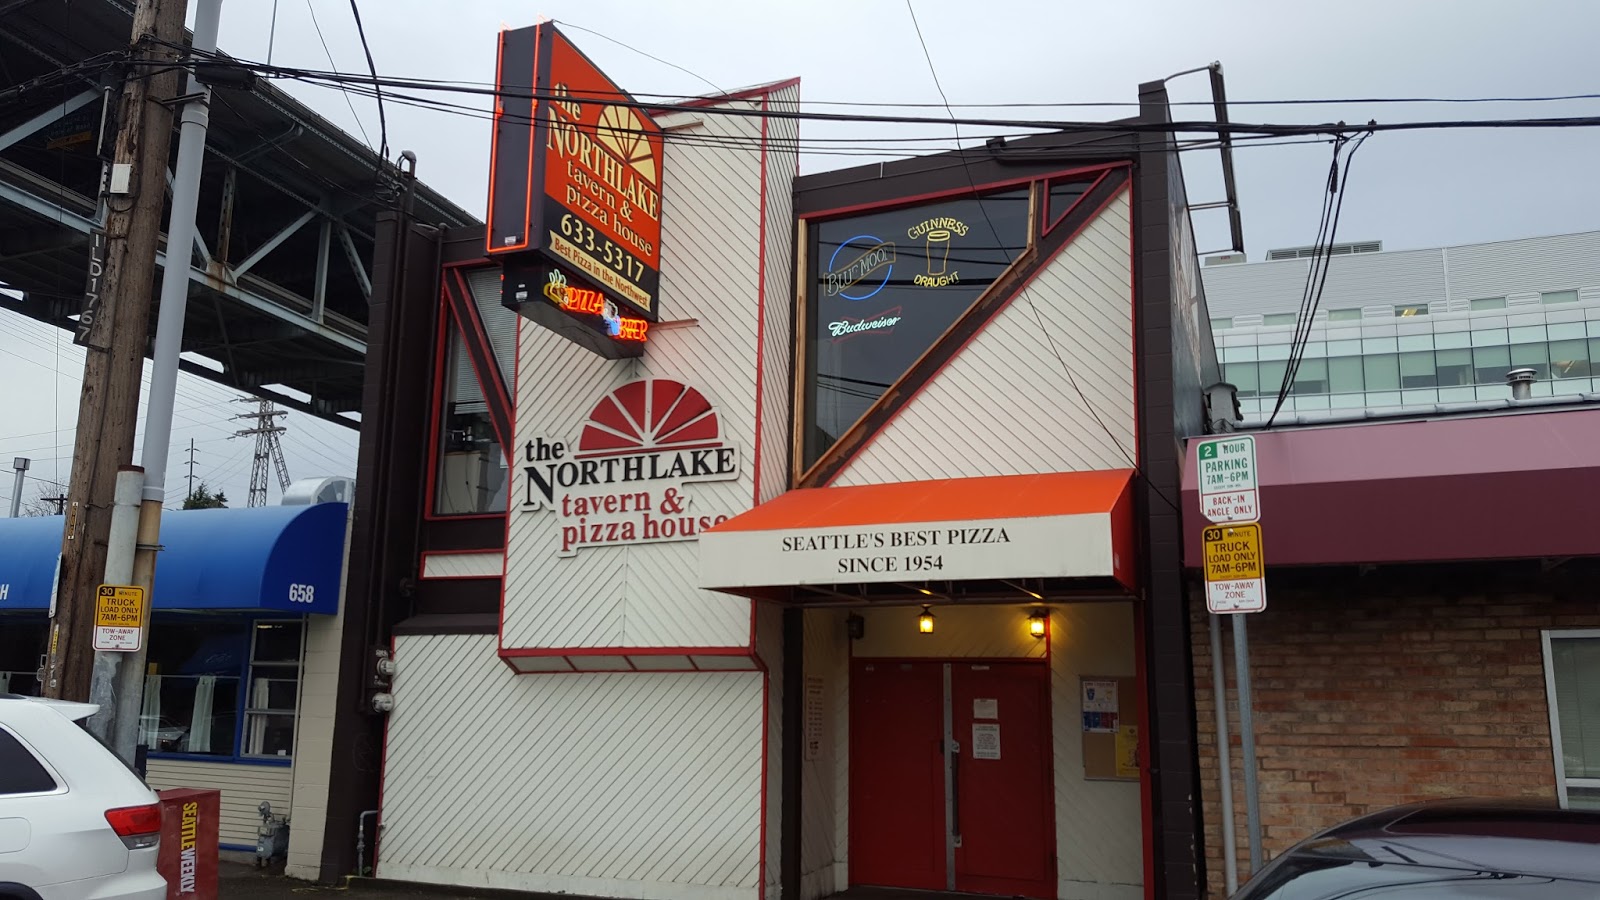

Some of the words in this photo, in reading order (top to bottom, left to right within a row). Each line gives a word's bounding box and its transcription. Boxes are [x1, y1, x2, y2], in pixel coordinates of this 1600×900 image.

[554, 83, 581, 120] the
[546, 106, 659, 221] NORTHLAKE
[567, 159, 615, 210] tavern
[619, 201, 633, 222] &
[566, 184, 608, 226] pizza
[613, 213, 652, 257] house
[907, 216, 970, 240] GUINNESS
[560, 213, 645, 283] 633-5317
[554, 237, 571, 252] Best
[573, 250, 592, 271] Pizza
[593, 262, 601, 273] in
[602, 269, 614, 285] the
[614, 275, 648, 307] Northwest
[913, 271, 960, 288] DRAUGHT
[567, 286, 605, 315] PIZZA
[827, 316, 902, 337] Budweiser
[525, 437, 564, 462] the
[1204, 445, 1212, 457] 2
[1223, 442, 1246, 454] HOUR
[1205, 457, 1248, 473] PARKING
[523, 447, 736, 507] NORTHLAKE
[1206, 470, 1249, 485] 7AM-6PM
[561, 490, 651, 517] tavern
[659, 487, 685, 515] &
[1212, 495, 1246, 505] BACK-IN
[1207, 506, 1230, 517] ANGLE
[1234, 504, 1253, 515] ONLY
[562, 517, 636, 552] pizza
[782, 532, 885, 552] SEATTLE'S
[890, 529, 941, 548] BEST
[947, 527, 1011, 545] PIZZA
[1207, 529, 1220, 540] 30
[1213, 541, 1250, 553] TRUCK
[837, 556, 898, 574] SINCE
[904, 555, 944, 571] 1954
[1208, 553, 1232, 563] LOAD
[1233, 551, 1256, 561] ONLY
[1211, 561, 1257, 574] 7AM-6PM
[101, 587, 114, 596] 30
[288, 582, 315, 604] 658
[1214, 581, 1255, 591] TOW-AWAY
[1224, 590, 1246, 599] ZONE
[106, 597, 135, 607] TRUCK
[121, 606, 139, 614] ONLY
[101, 613, 138, 622] 7AM-6PM
